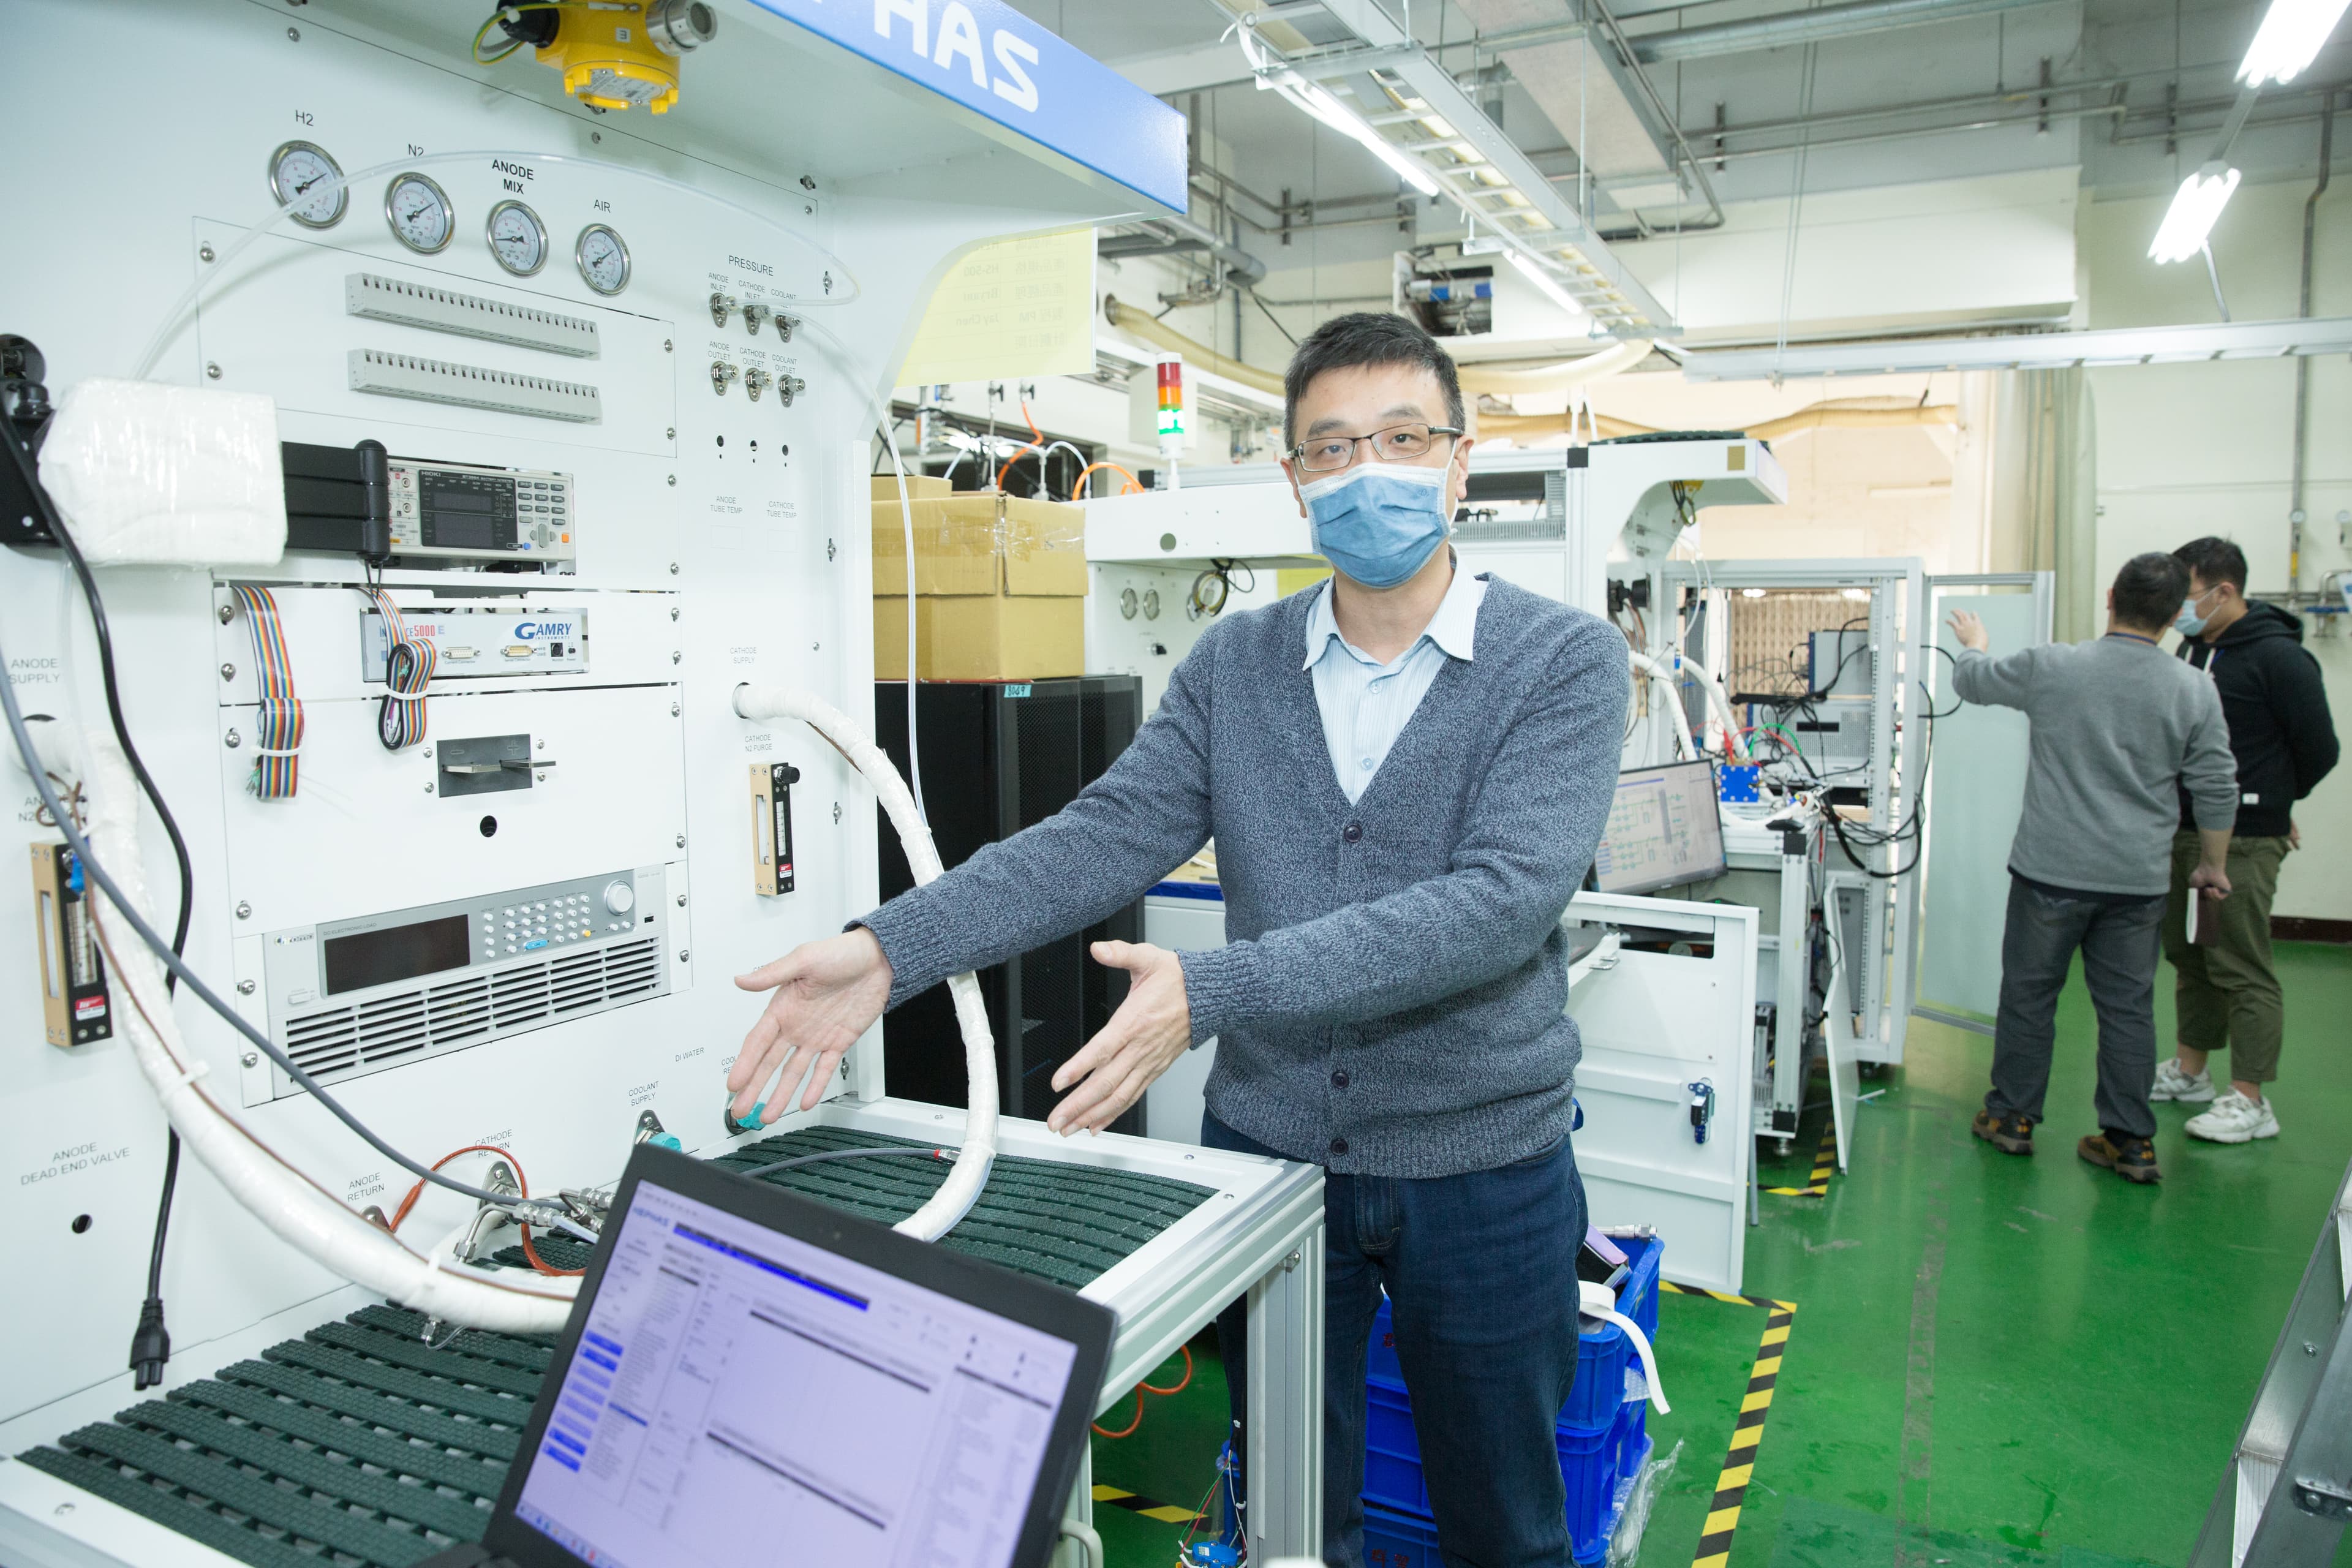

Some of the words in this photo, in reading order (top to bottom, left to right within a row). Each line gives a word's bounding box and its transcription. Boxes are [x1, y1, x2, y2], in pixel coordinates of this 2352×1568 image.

[804, 0, 1039, 113] HAS
[295, 110, 314, 126] H2
[408, 143, 424, 157] N2
[492, 159, 534, 180] ANODE
[503, 178, 524, 194] MIX
[594, 199, 611, 213] AIR
[729, 255, 774, 276] PRESSURE
[709, 273, 729, 284] ANODE
[710, 282, 727, 293] INLET
[739, 280, 765, 293] CATHODE
[771, 288, 797, 300] COOLANT
[709, 341, 730, 351] ANODE
[708, 350, 731, 361] OUTLET
[739, 347, 766, 359] CATHODE
[772, 354, 797, 364] COOLANT
[743, 357, 765, 368] OUTLET
[775, 364, 796, 374] OUTLET
[716, 496, 736, 504] ANODE
[769, 500, 794, 510] CATHODE
[514, 622, 572, 639] GAMRY
[11, 658, 58, 668] ANODE
[9, 674, 60, 684] SUPPLY
[745, 734, 771, 742] CATHODE
[331, 925, 363, 935] ELECTRONIC
[682, 1047, 704, 1060] WATER
[721, 1055, 736, 1066] COOL
[628, 1080, 659, 1097] COOLANT
[631, 1092, 655, 1106] SUPPLY
[475, 1129, 513, 1147] CATHODE
[52, 1142, 98, 1163] ANODE
[478, 1141, 510, 1158] RERN
[21, 1167, 57, 1185] DEAD
[61, 1159, 88, 1174] END
[91, 1147, 130, 1165] VALVE
[349, 1172, 381, 1189] ANODE
[347, 1183, 385, 1202] RETURN
